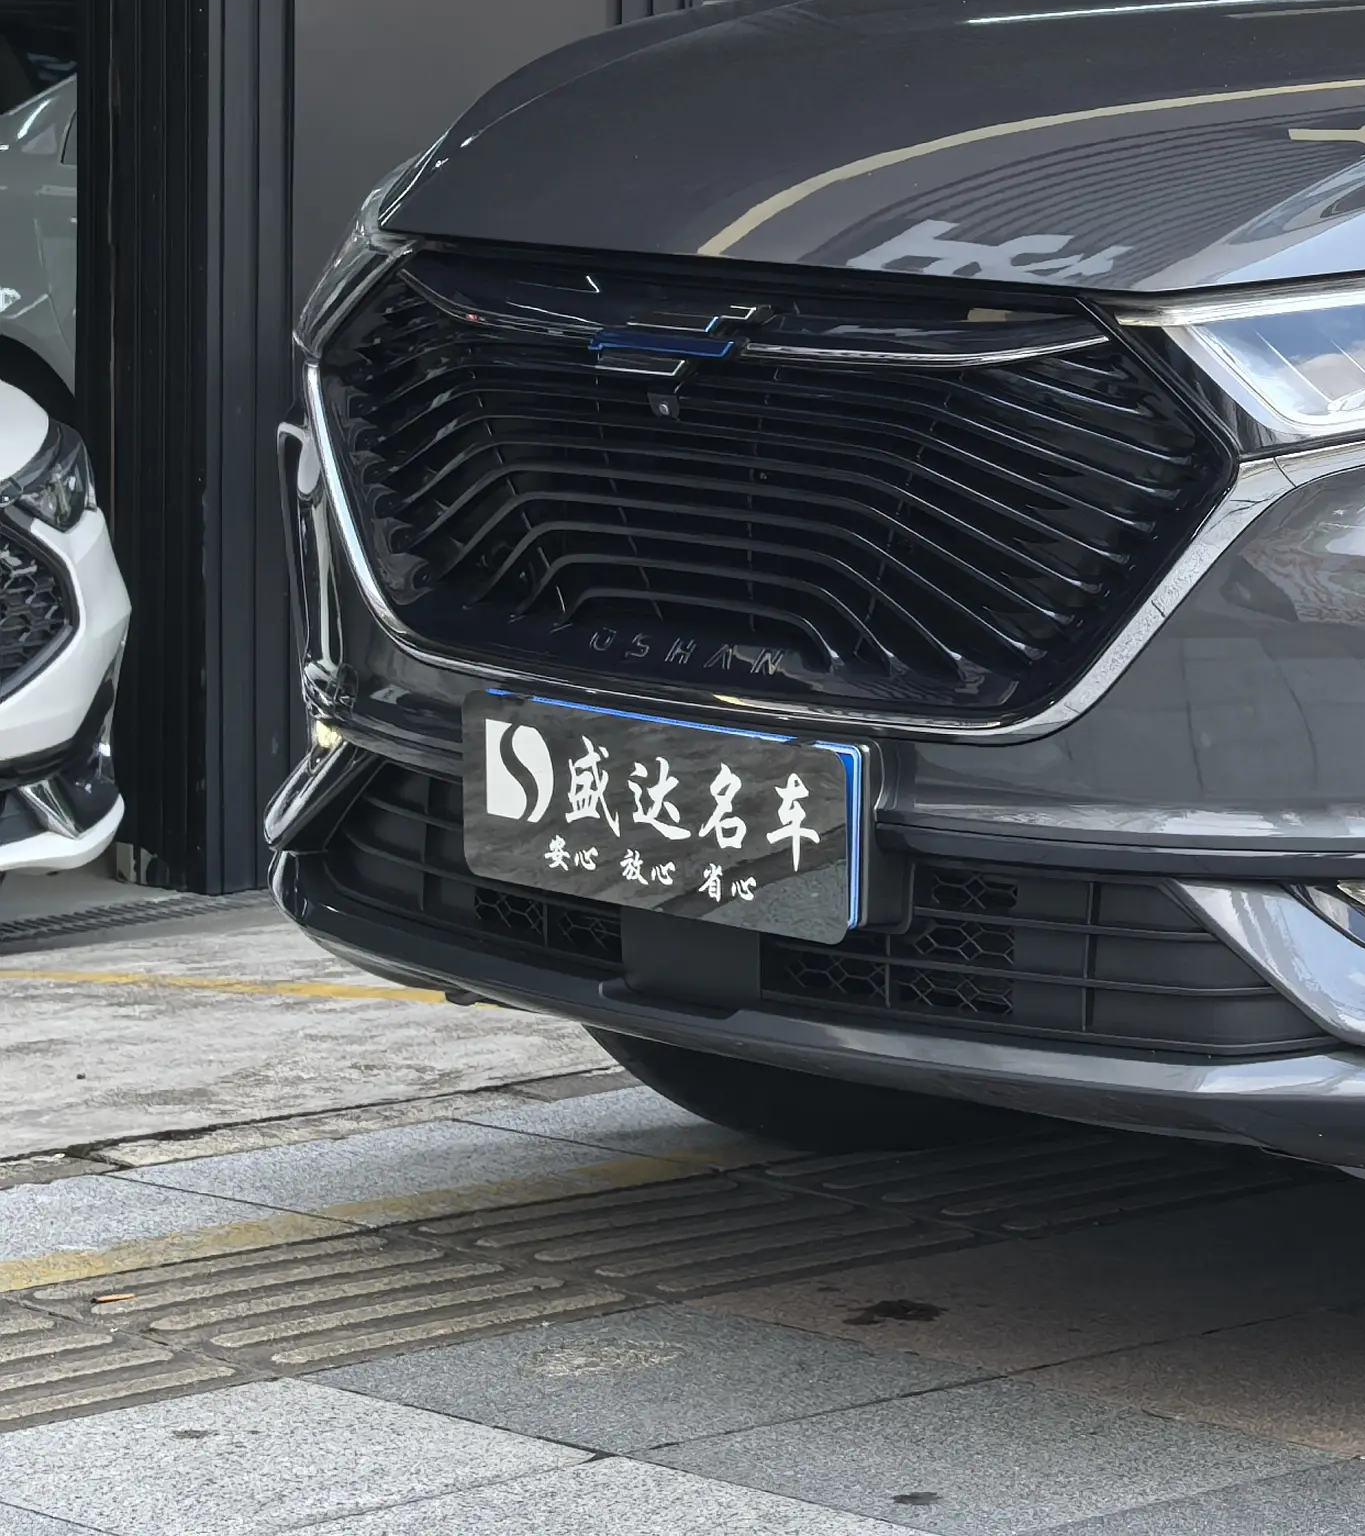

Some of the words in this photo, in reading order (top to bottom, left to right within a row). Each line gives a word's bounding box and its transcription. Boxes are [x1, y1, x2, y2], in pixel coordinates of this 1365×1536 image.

[588, 626, 785, 676] OSHAN
[565, 735, 821, 872] 盛达名车
[543, 835, 599, 872] 安心
[619, 849, 676, 886] 放心
[698, 864, 758, 903] 省心
